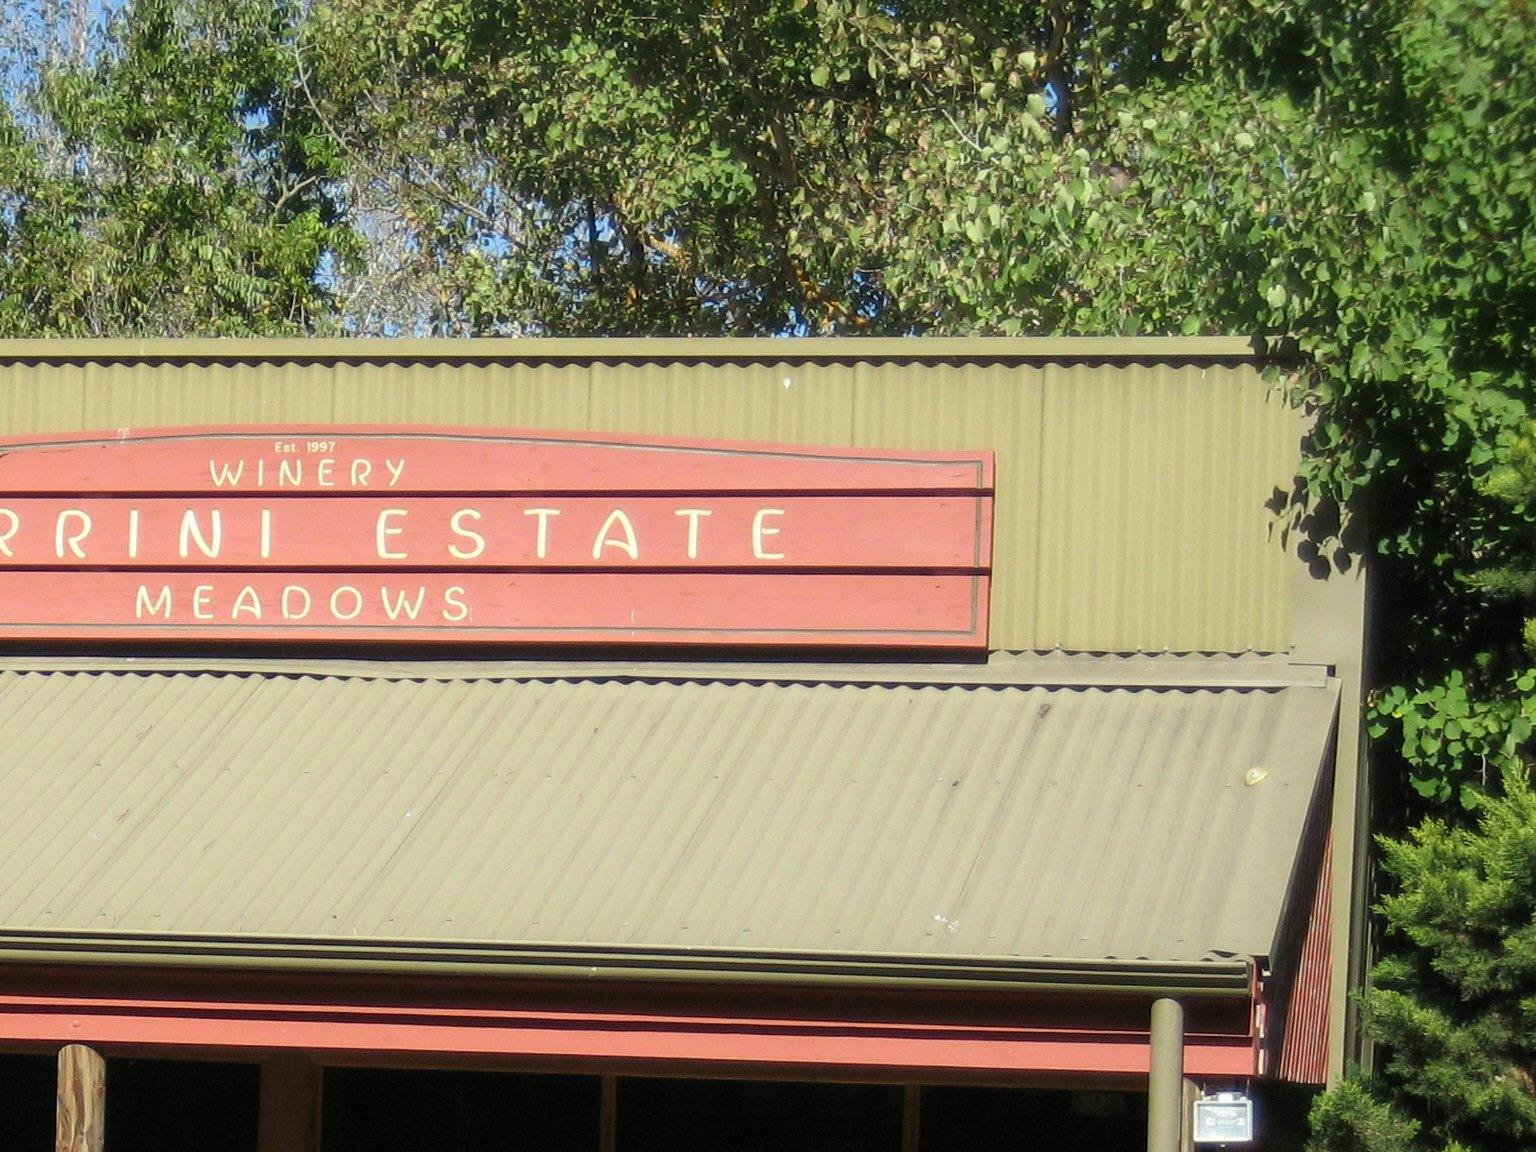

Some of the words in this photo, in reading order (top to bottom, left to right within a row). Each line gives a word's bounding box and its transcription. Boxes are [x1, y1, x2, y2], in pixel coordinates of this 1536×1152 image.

[274, 441, 299, 454] Est.
[306, 441, 337, 454] 1997
[209, 458, 405, 488] WINERY
[374, 508, 786, 561] ESTATE
[134, 584, 470, 622] MEADOWS
